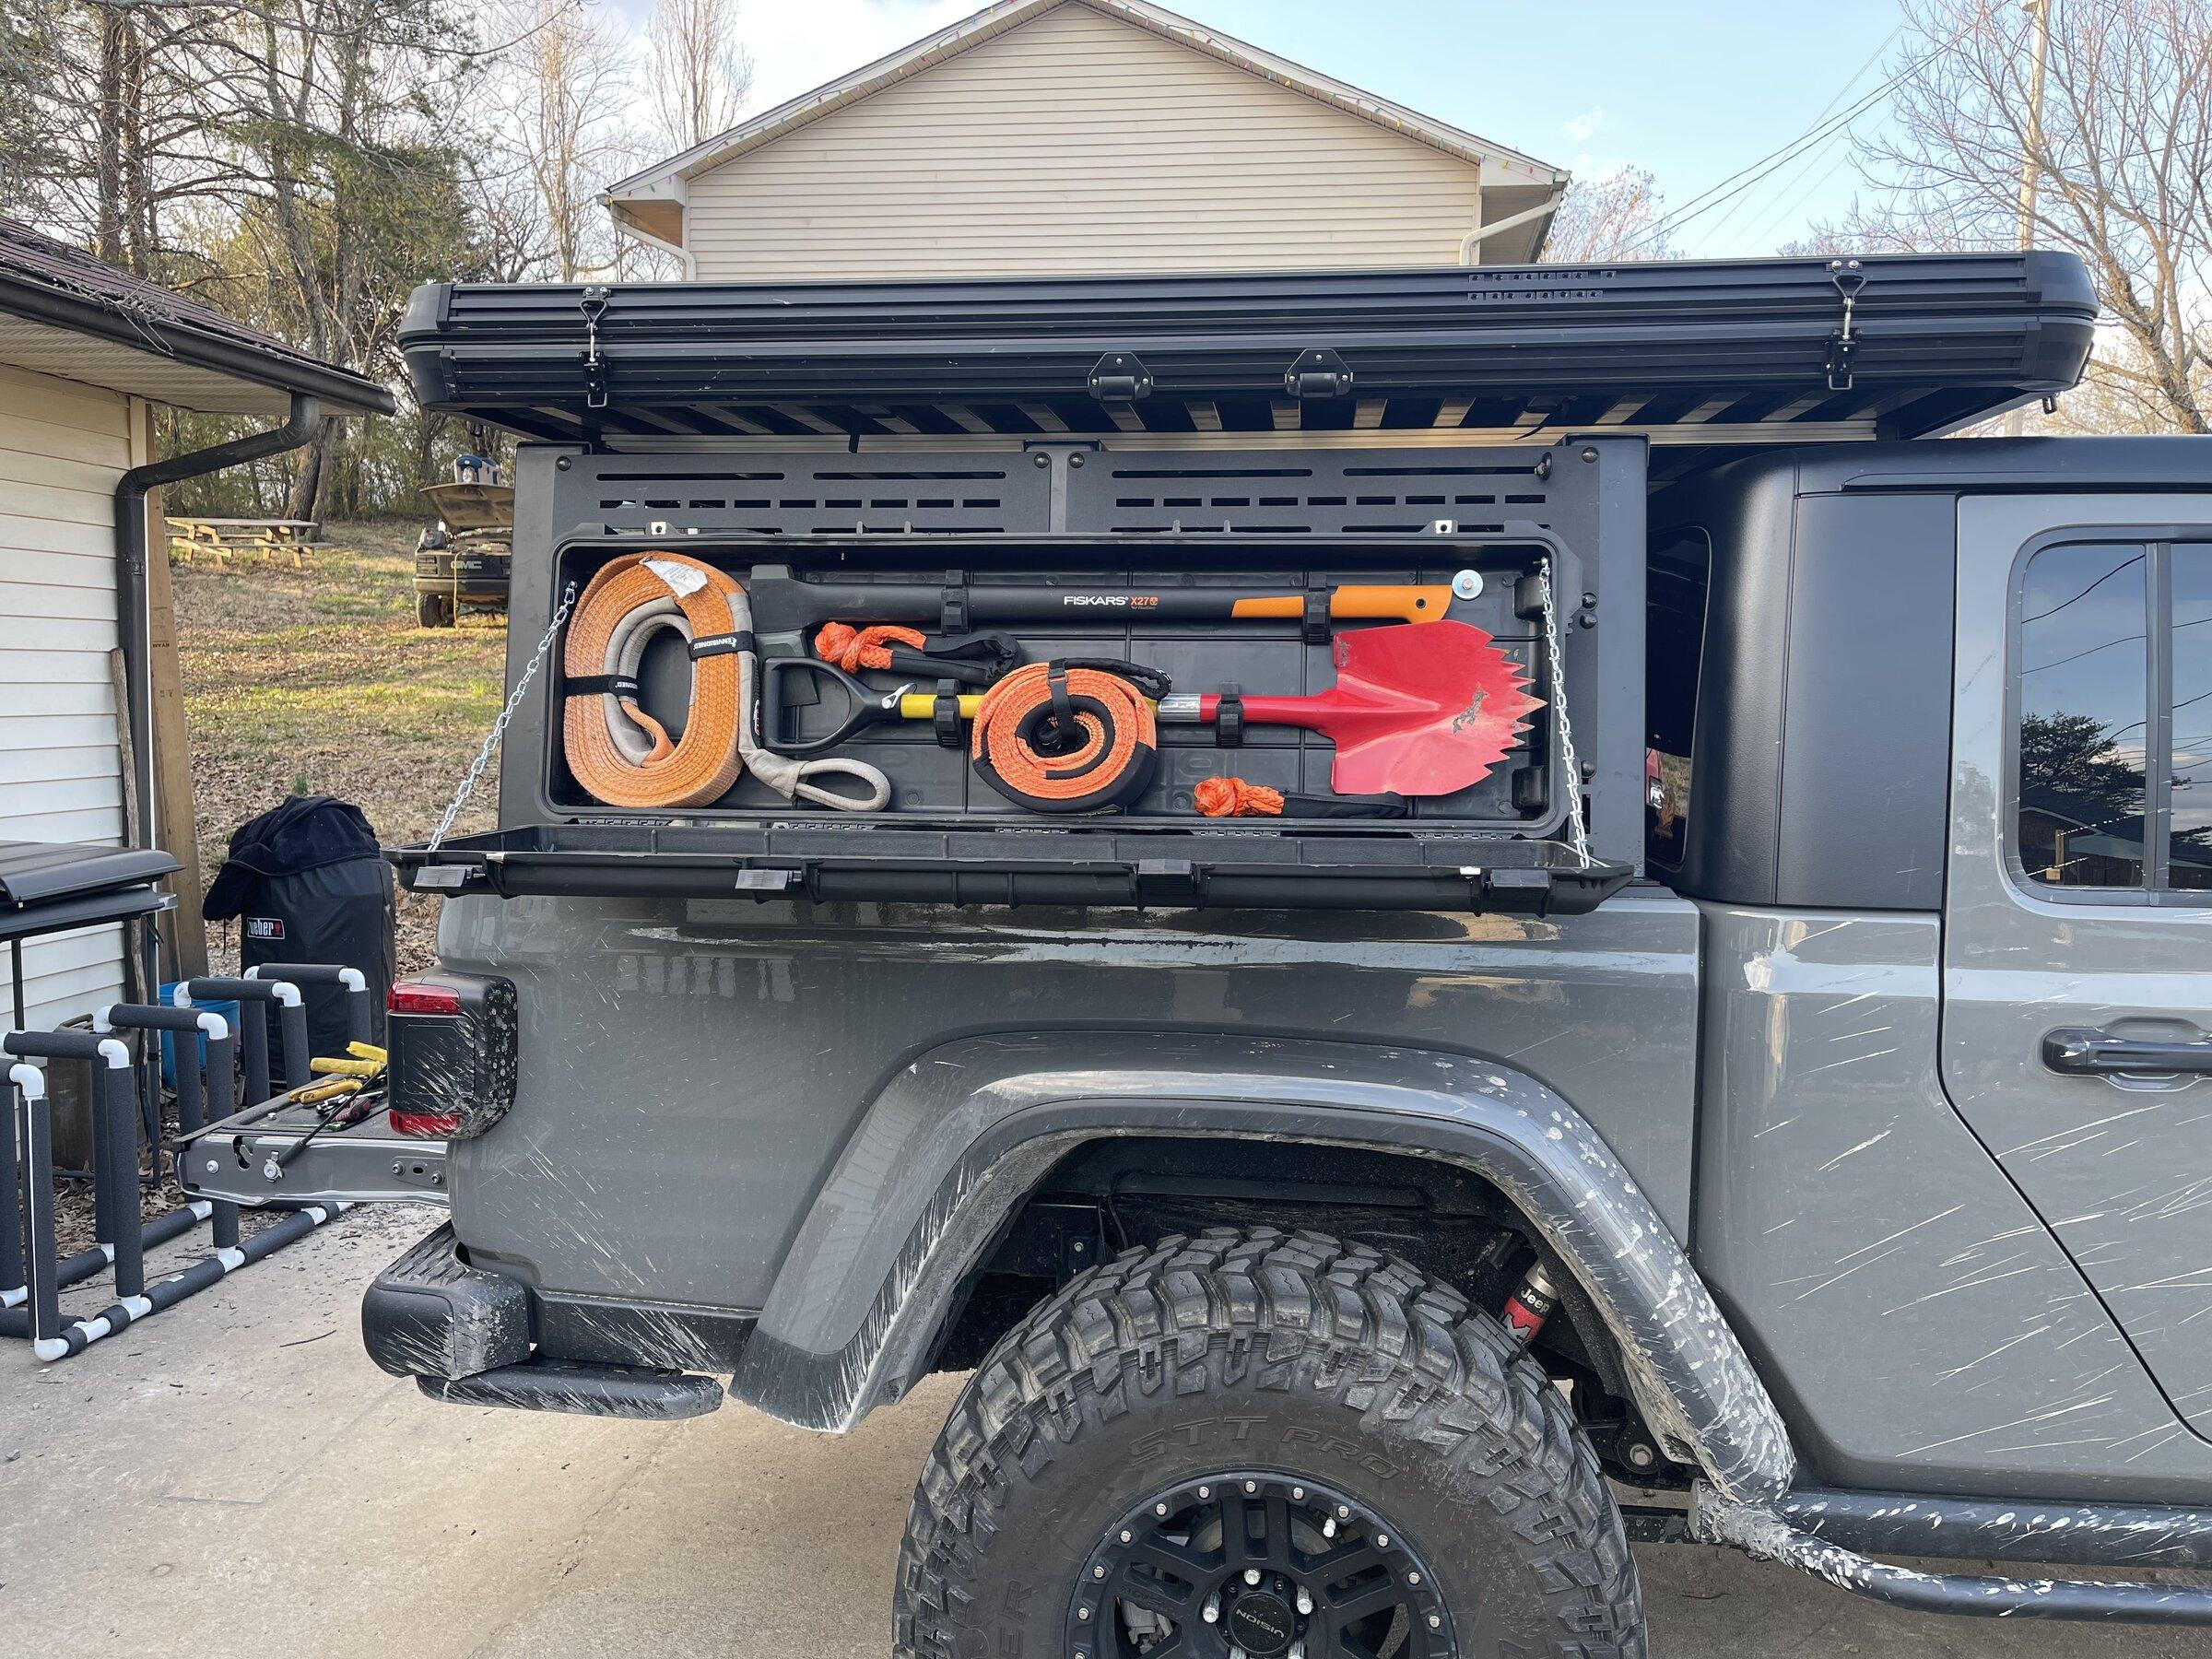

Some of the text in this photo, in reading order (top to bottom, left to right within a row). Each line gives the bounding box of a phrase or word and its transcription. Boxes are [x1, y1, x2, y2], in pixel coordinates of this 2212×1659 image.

[451, 560, 482, 570] GMC
[1064, 595, 1149, 606] FISKARS X27
[249, 918, 274, 936] weber
[1520, 1288, 1550, 1313] Jeep
[1128, 1415, 1401, 1480] STT PRO
